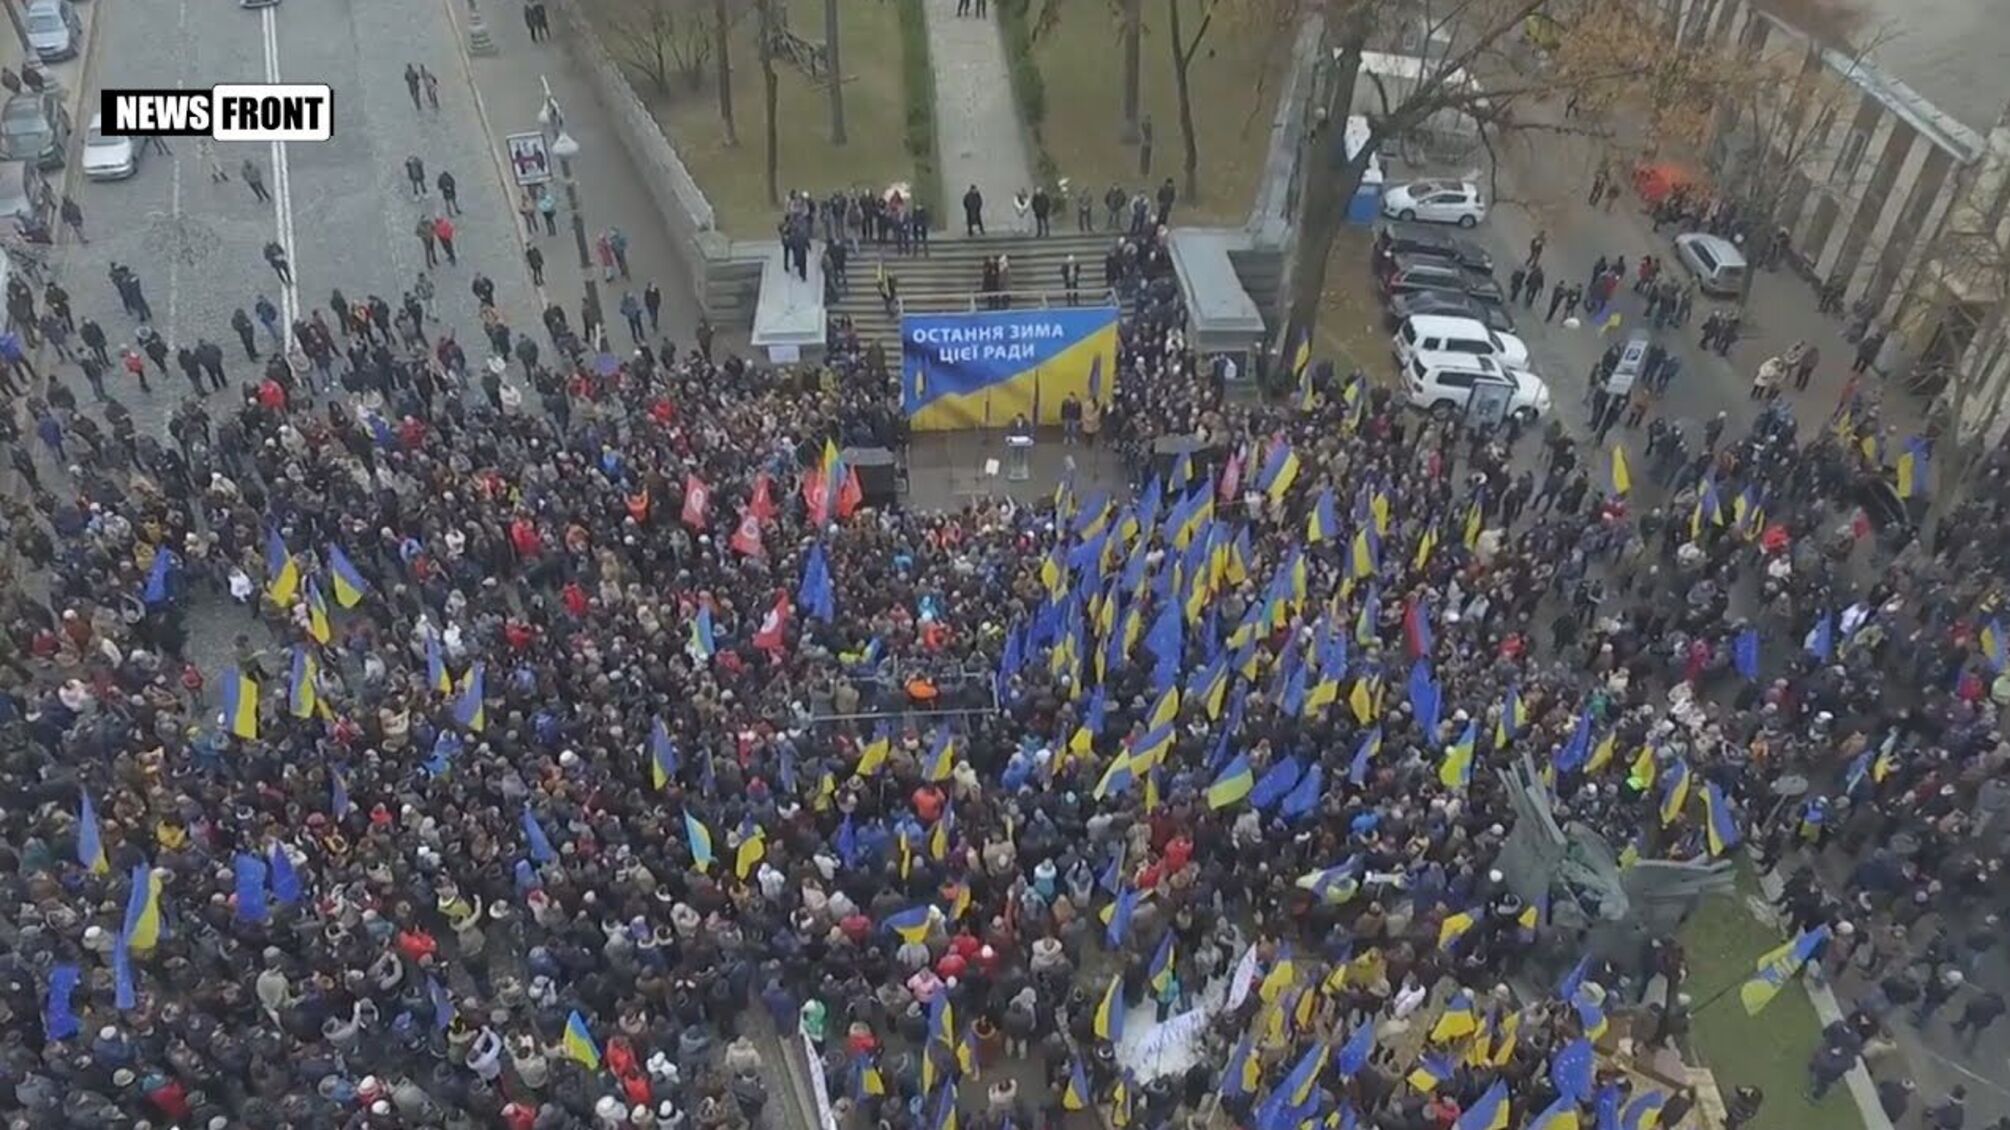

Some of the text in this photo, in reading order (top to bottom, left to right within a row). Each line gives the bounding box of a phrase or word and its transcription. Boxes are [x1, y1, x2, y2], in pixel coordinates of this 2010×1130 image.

[913, 324, 1064, 343] ОСТАННЯ ЗИМА
[939, 344, 1035, 364] ЦІЄЇ РАДИ
